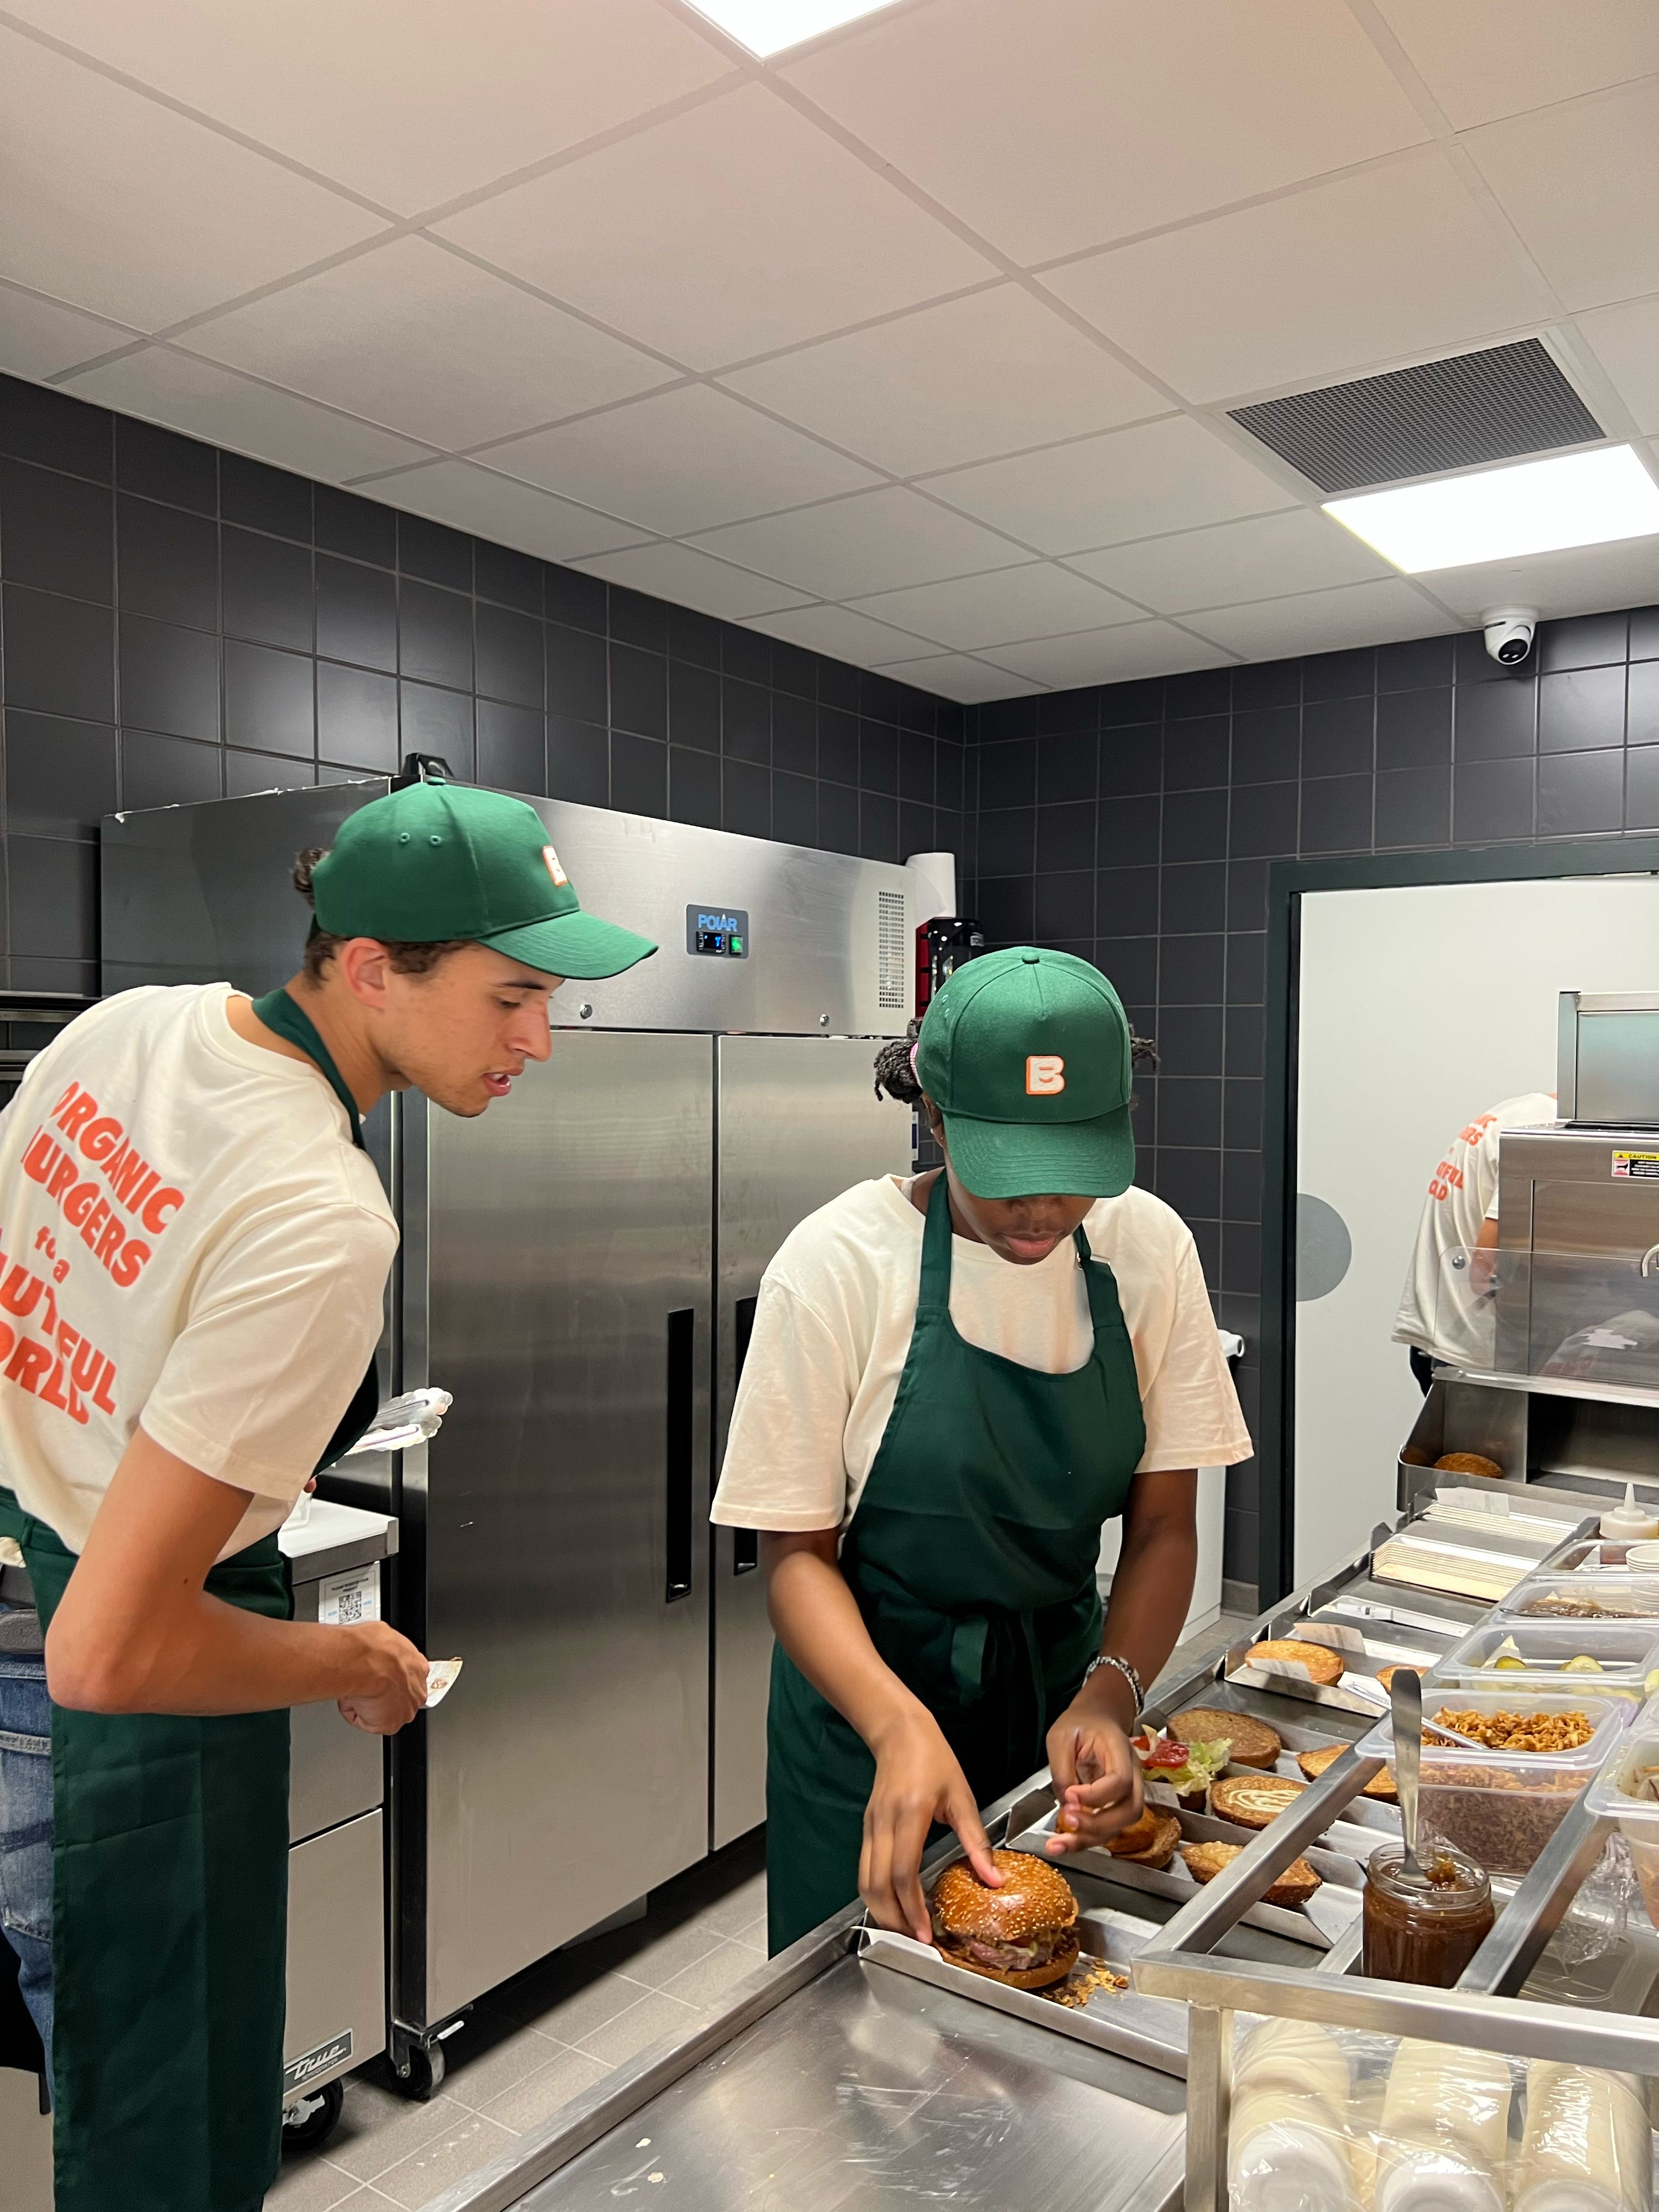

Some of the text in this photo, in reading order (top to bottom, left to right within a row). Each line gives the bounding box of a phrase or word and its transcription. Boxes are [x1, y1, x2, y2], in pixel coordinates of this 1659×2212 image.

[698, 914, 738, 932] POLAR
[1026, 1055, 1065, 1095] B
[20, 1124, 152, 1287] URGERS
